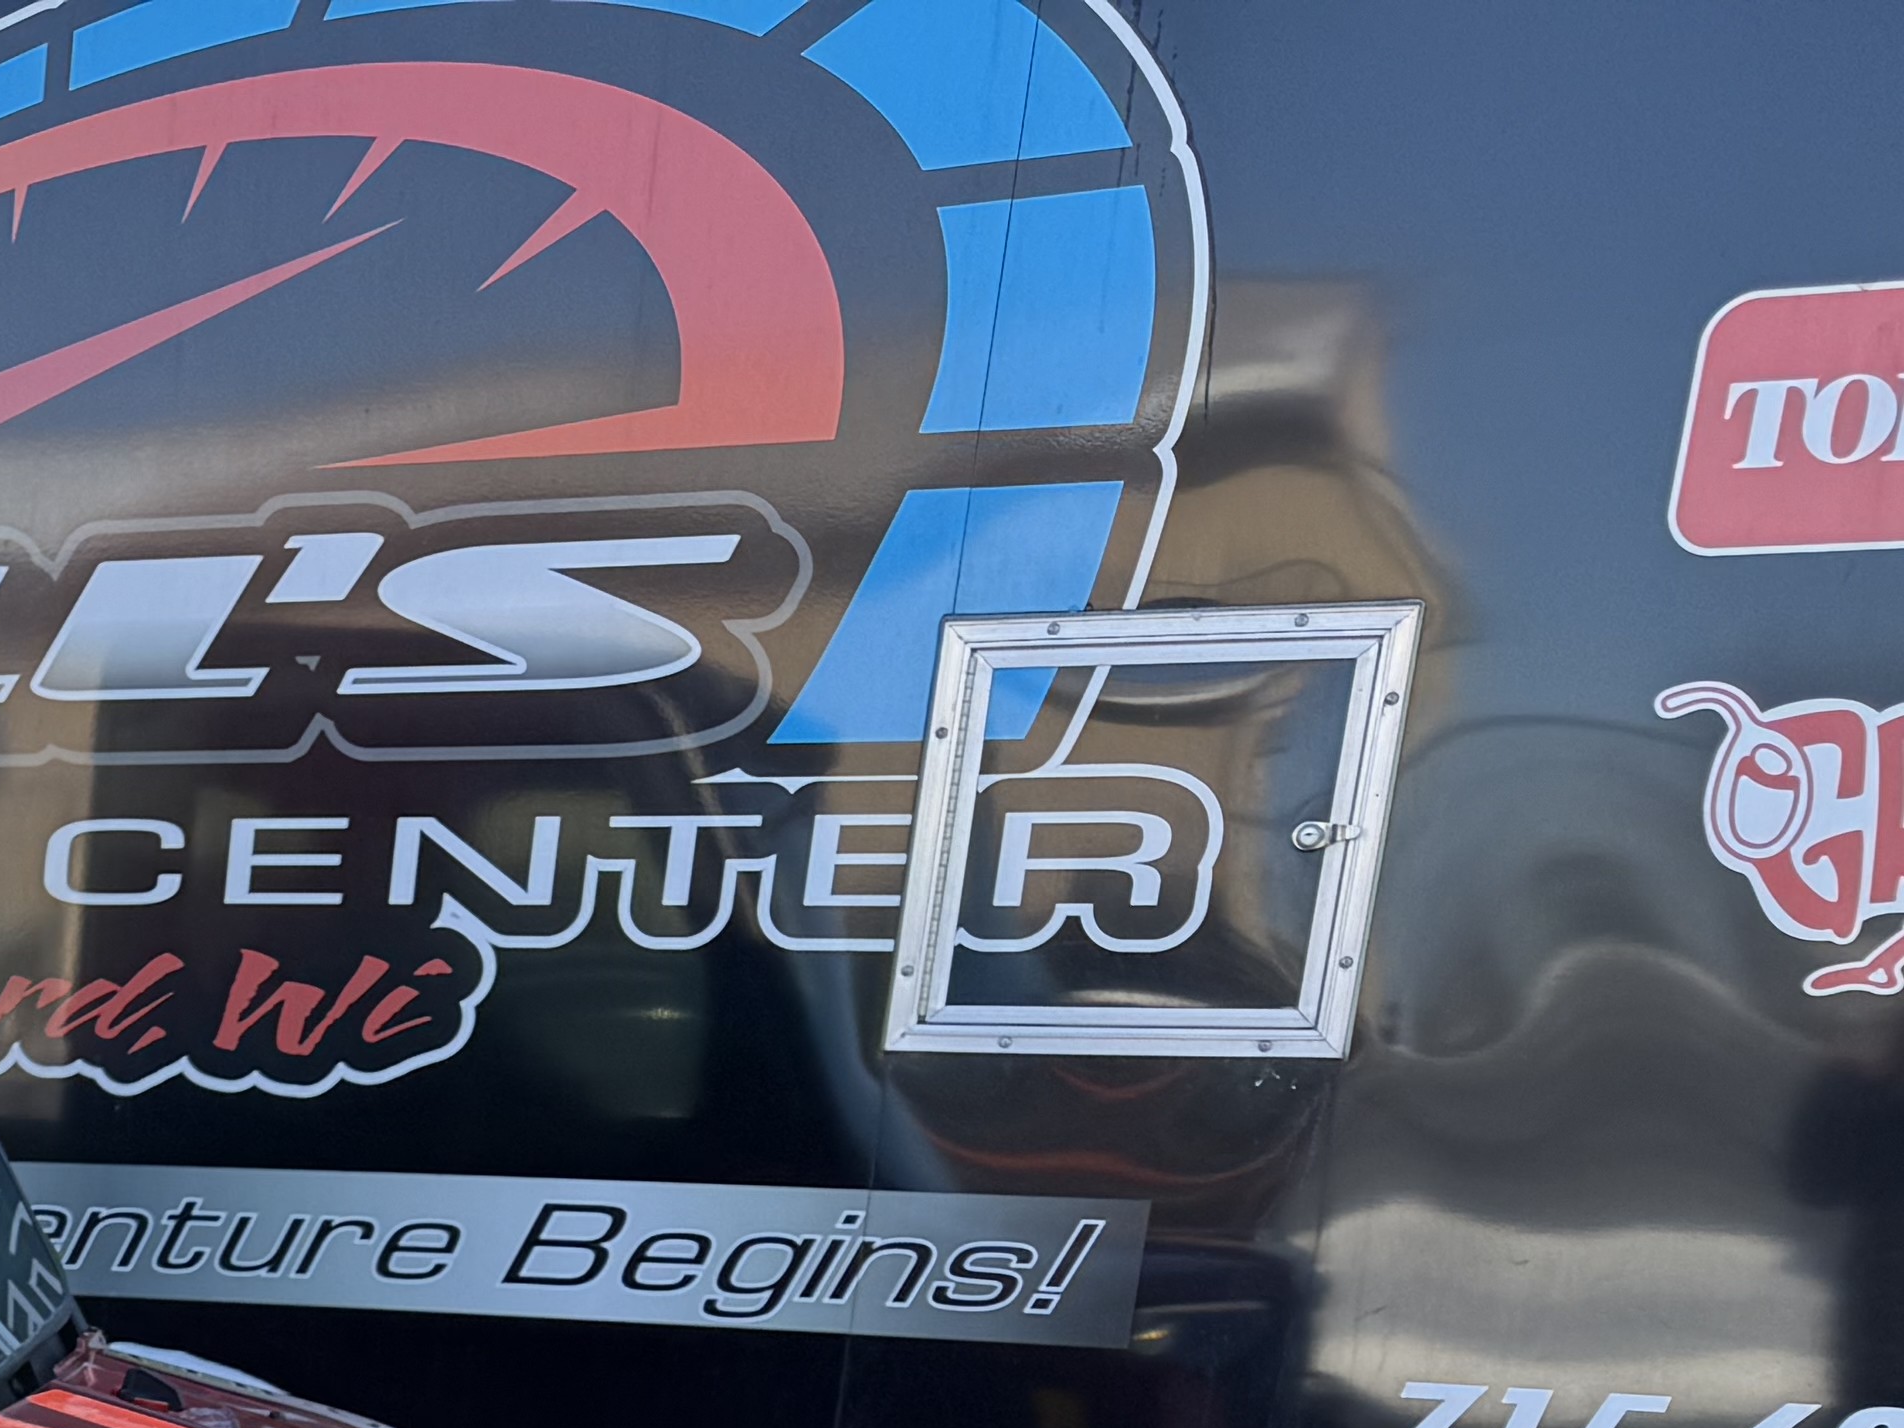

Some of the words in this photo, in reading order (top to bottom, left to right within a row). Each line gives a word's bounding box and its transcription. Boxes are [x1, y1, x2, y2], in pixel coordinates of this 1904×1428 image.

[1723, 373, 1904, 469] TO
[43, 811, 1174, 908] CENTER
[213, 948, 453, 1056] Wi
[500, 1202, 1106, 1320] Begins!
